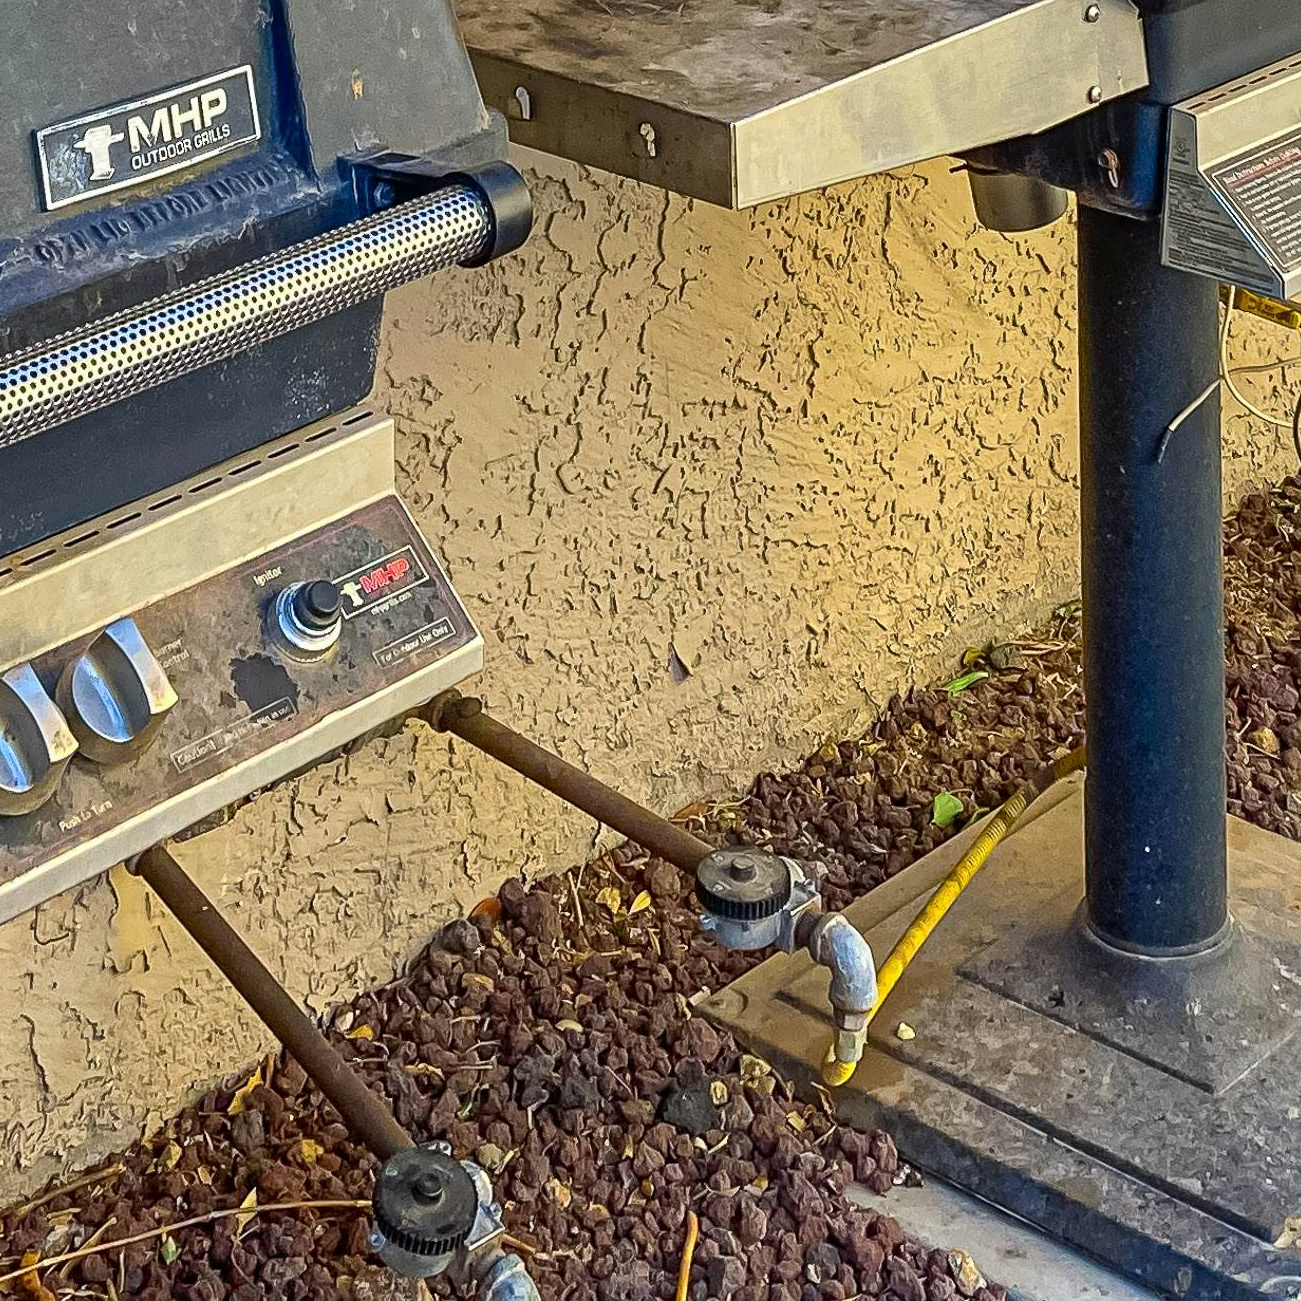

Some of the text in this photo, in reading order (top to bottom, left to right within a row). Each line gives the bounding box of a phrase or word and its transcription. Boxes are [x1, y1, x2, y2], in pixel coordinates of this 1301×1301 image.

[127, 88, 228, 153] MHP
[131, 123, 231, 171] OUTDOOR GRILLS
[253, 565, 284, 587] Ignitor
[359, 557, 410, 594] MHP
[59, 814, 81, 832] Push
[90, 799, 112, 816] Turn
